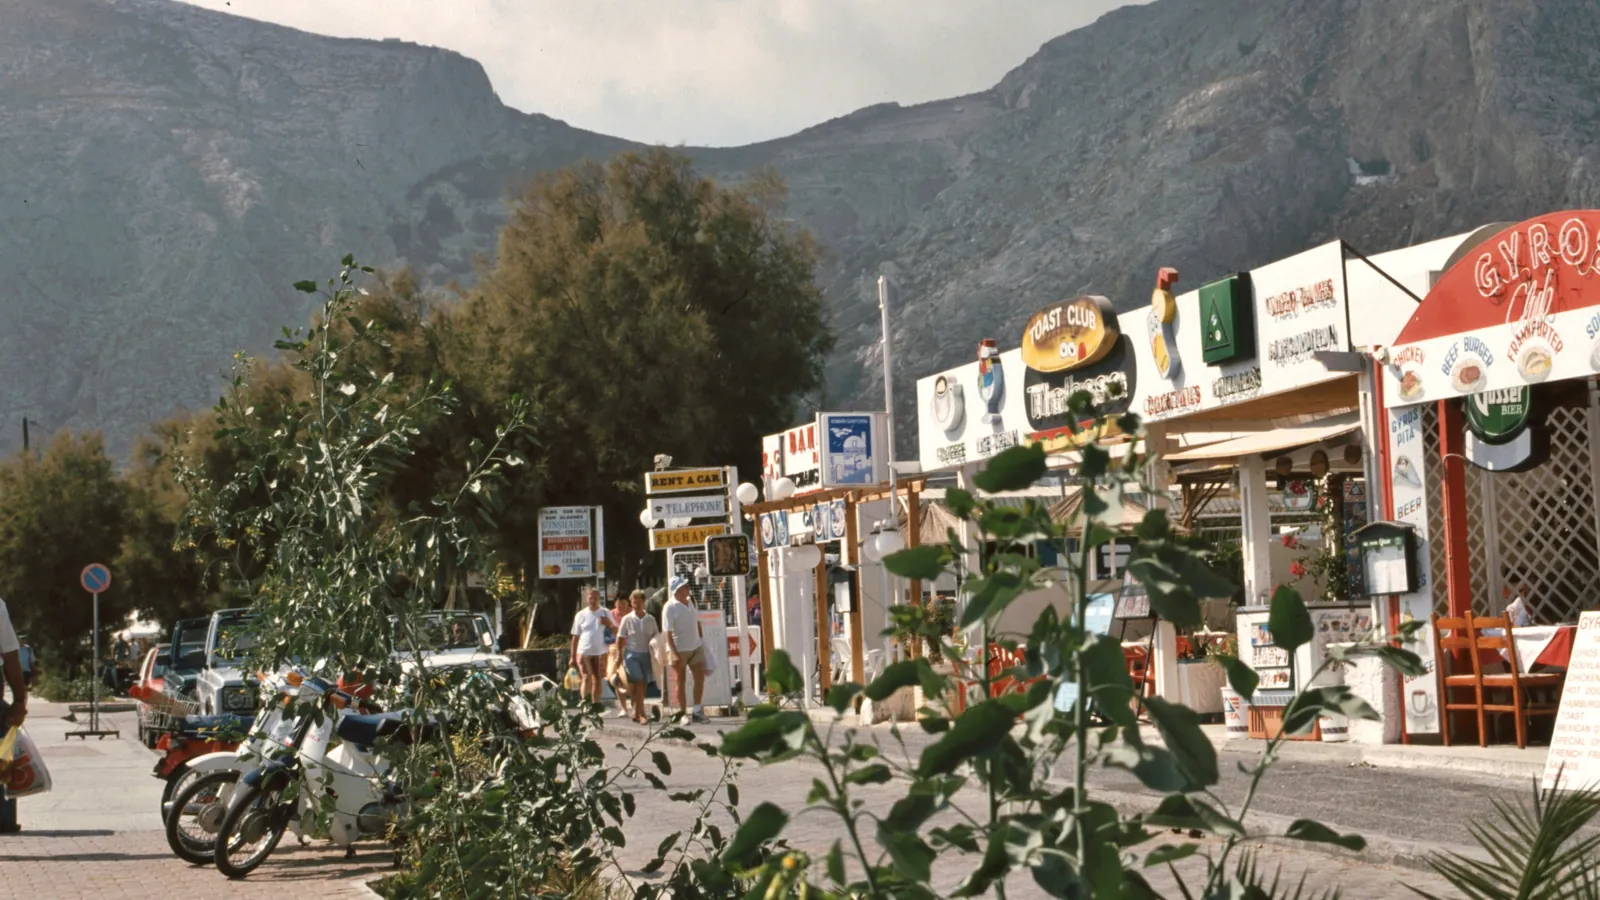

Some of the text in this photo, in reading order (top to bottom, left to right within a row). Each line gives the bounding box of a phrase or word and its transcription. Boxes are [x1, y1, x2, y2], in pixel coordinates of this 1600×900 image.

[1474, 218, 1600, 298] GYRO
[1029, 305, 1097, 345] TOAST CLUB
[1393, 346, 1426, 368] CHICKEN
[1442, 336, 1494, 376] BEEF BURGER
[1391, 407, 1418, 433] GYROS
[1501, 404, 1523, 416] BIER
[1397, 427, 1415, 447] PITA
[652, 474, 719, 487] RENT A CAR
[665, 500, 722, 515] TELEPHONE
[1397, 497, 1422, 519] BEER
[1561, 711, 1585, 720] TOAST
[1556, 723, 1591, 733] MEXICAN
[1553, 736, 1585, 746] SPECIAL
